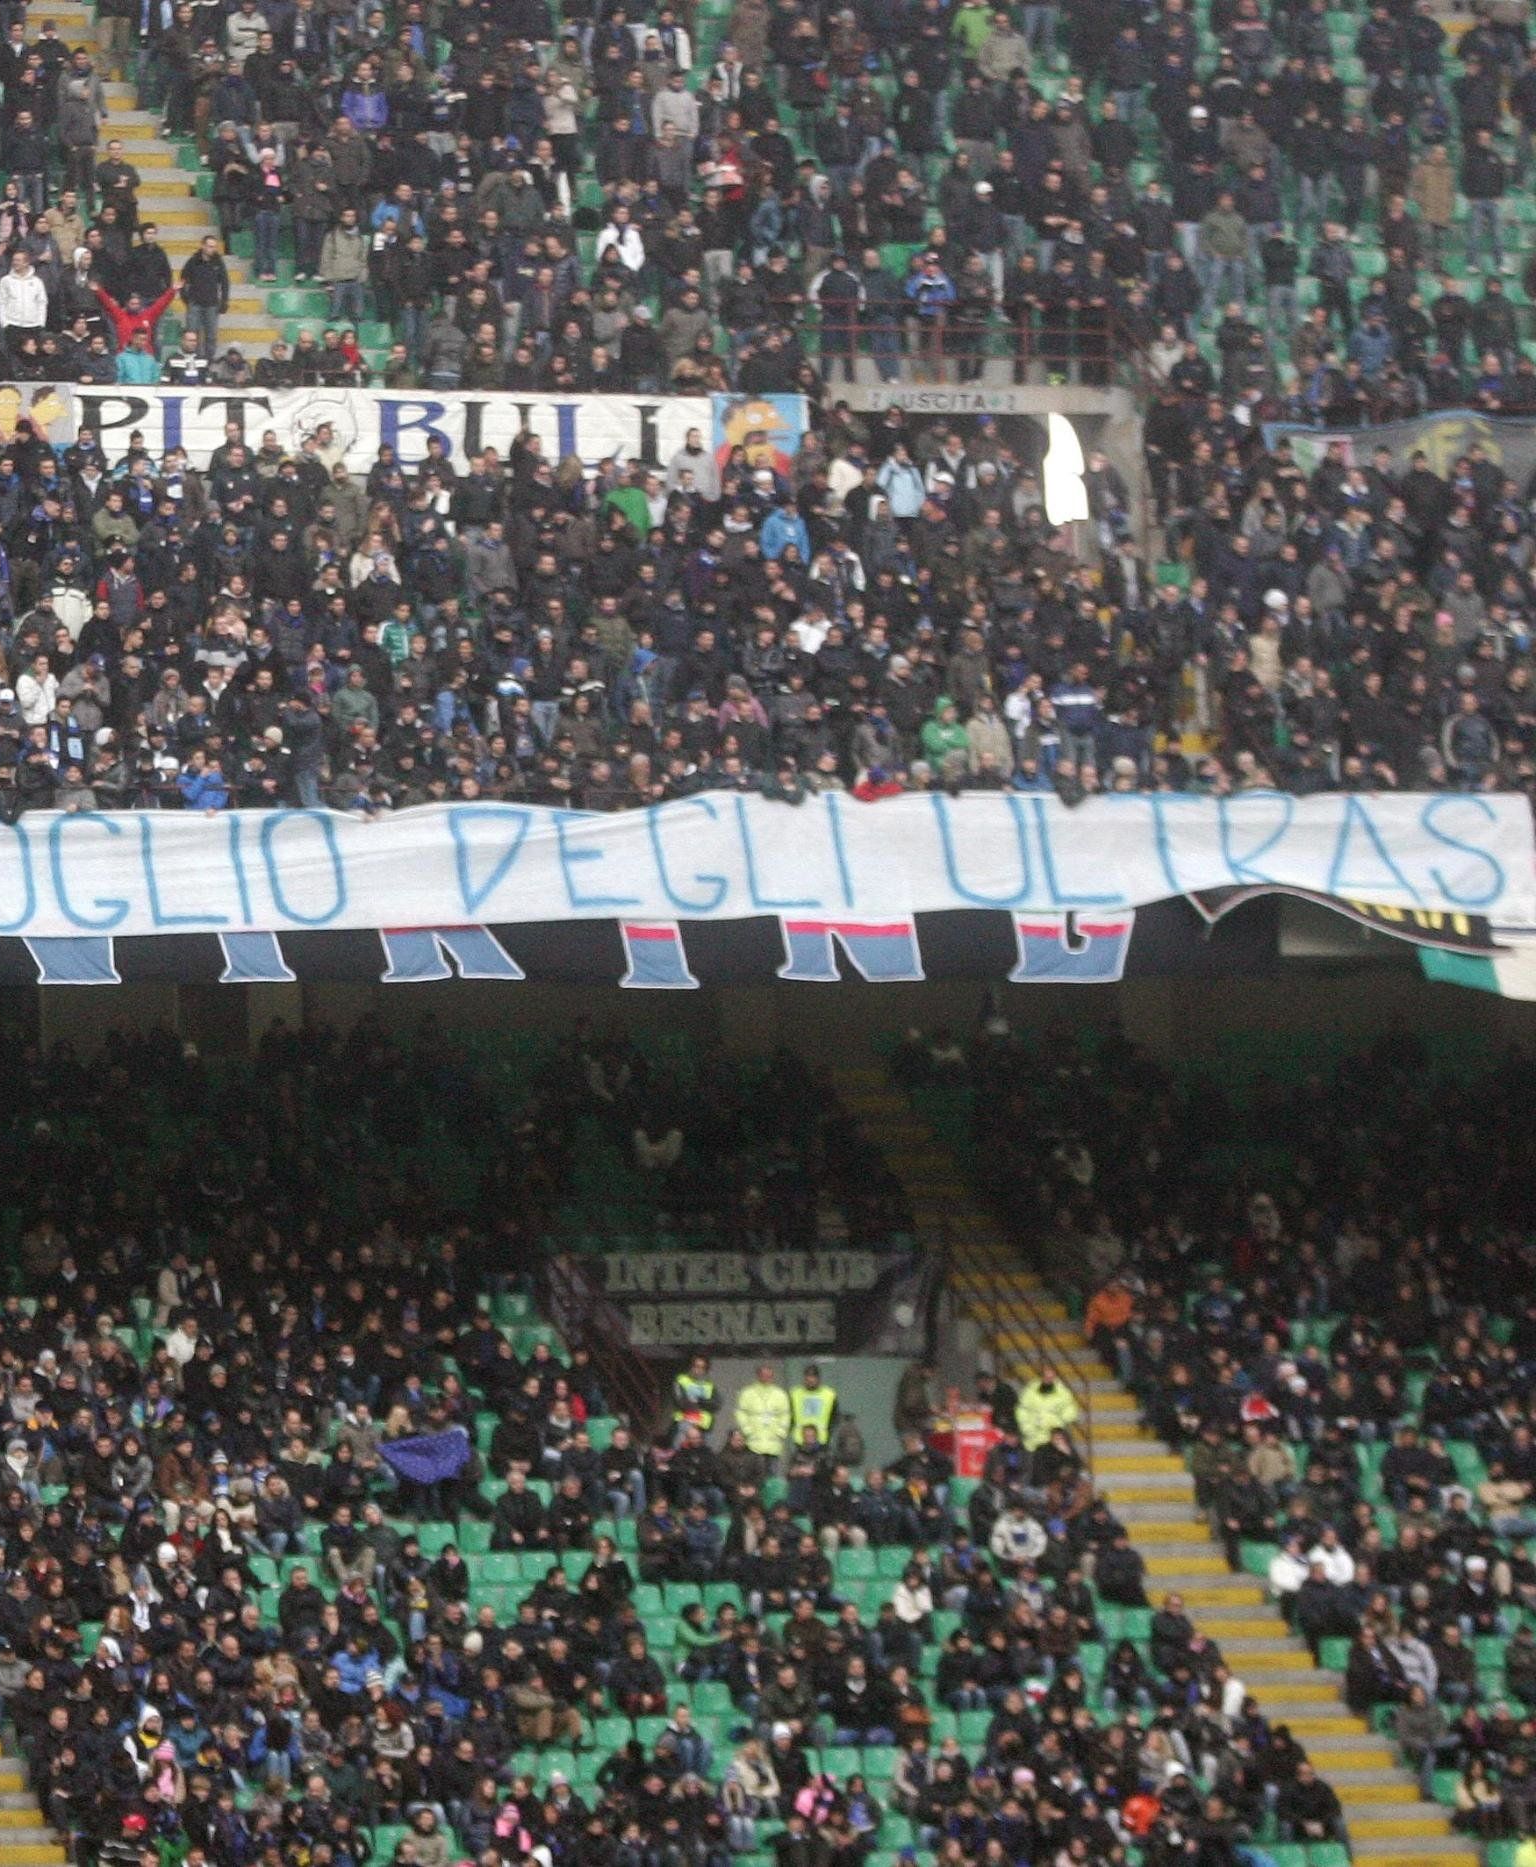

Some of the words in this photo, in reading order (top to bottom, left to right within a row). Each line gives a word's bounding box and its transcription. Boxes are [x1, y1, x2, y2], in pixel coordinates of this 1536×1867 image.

[902, 392, 986, 410] USCITA
[75, 394, 275, 471] PIT
[448, 793, 854, 915] DEGLI
[931, 790, 1506, 908] ULTRAS
[604, 1251, 749, 1292] INTER
[760, 1251, 877, 1292] CLUB
[628, 1301, 836, 1345] BESNATE
